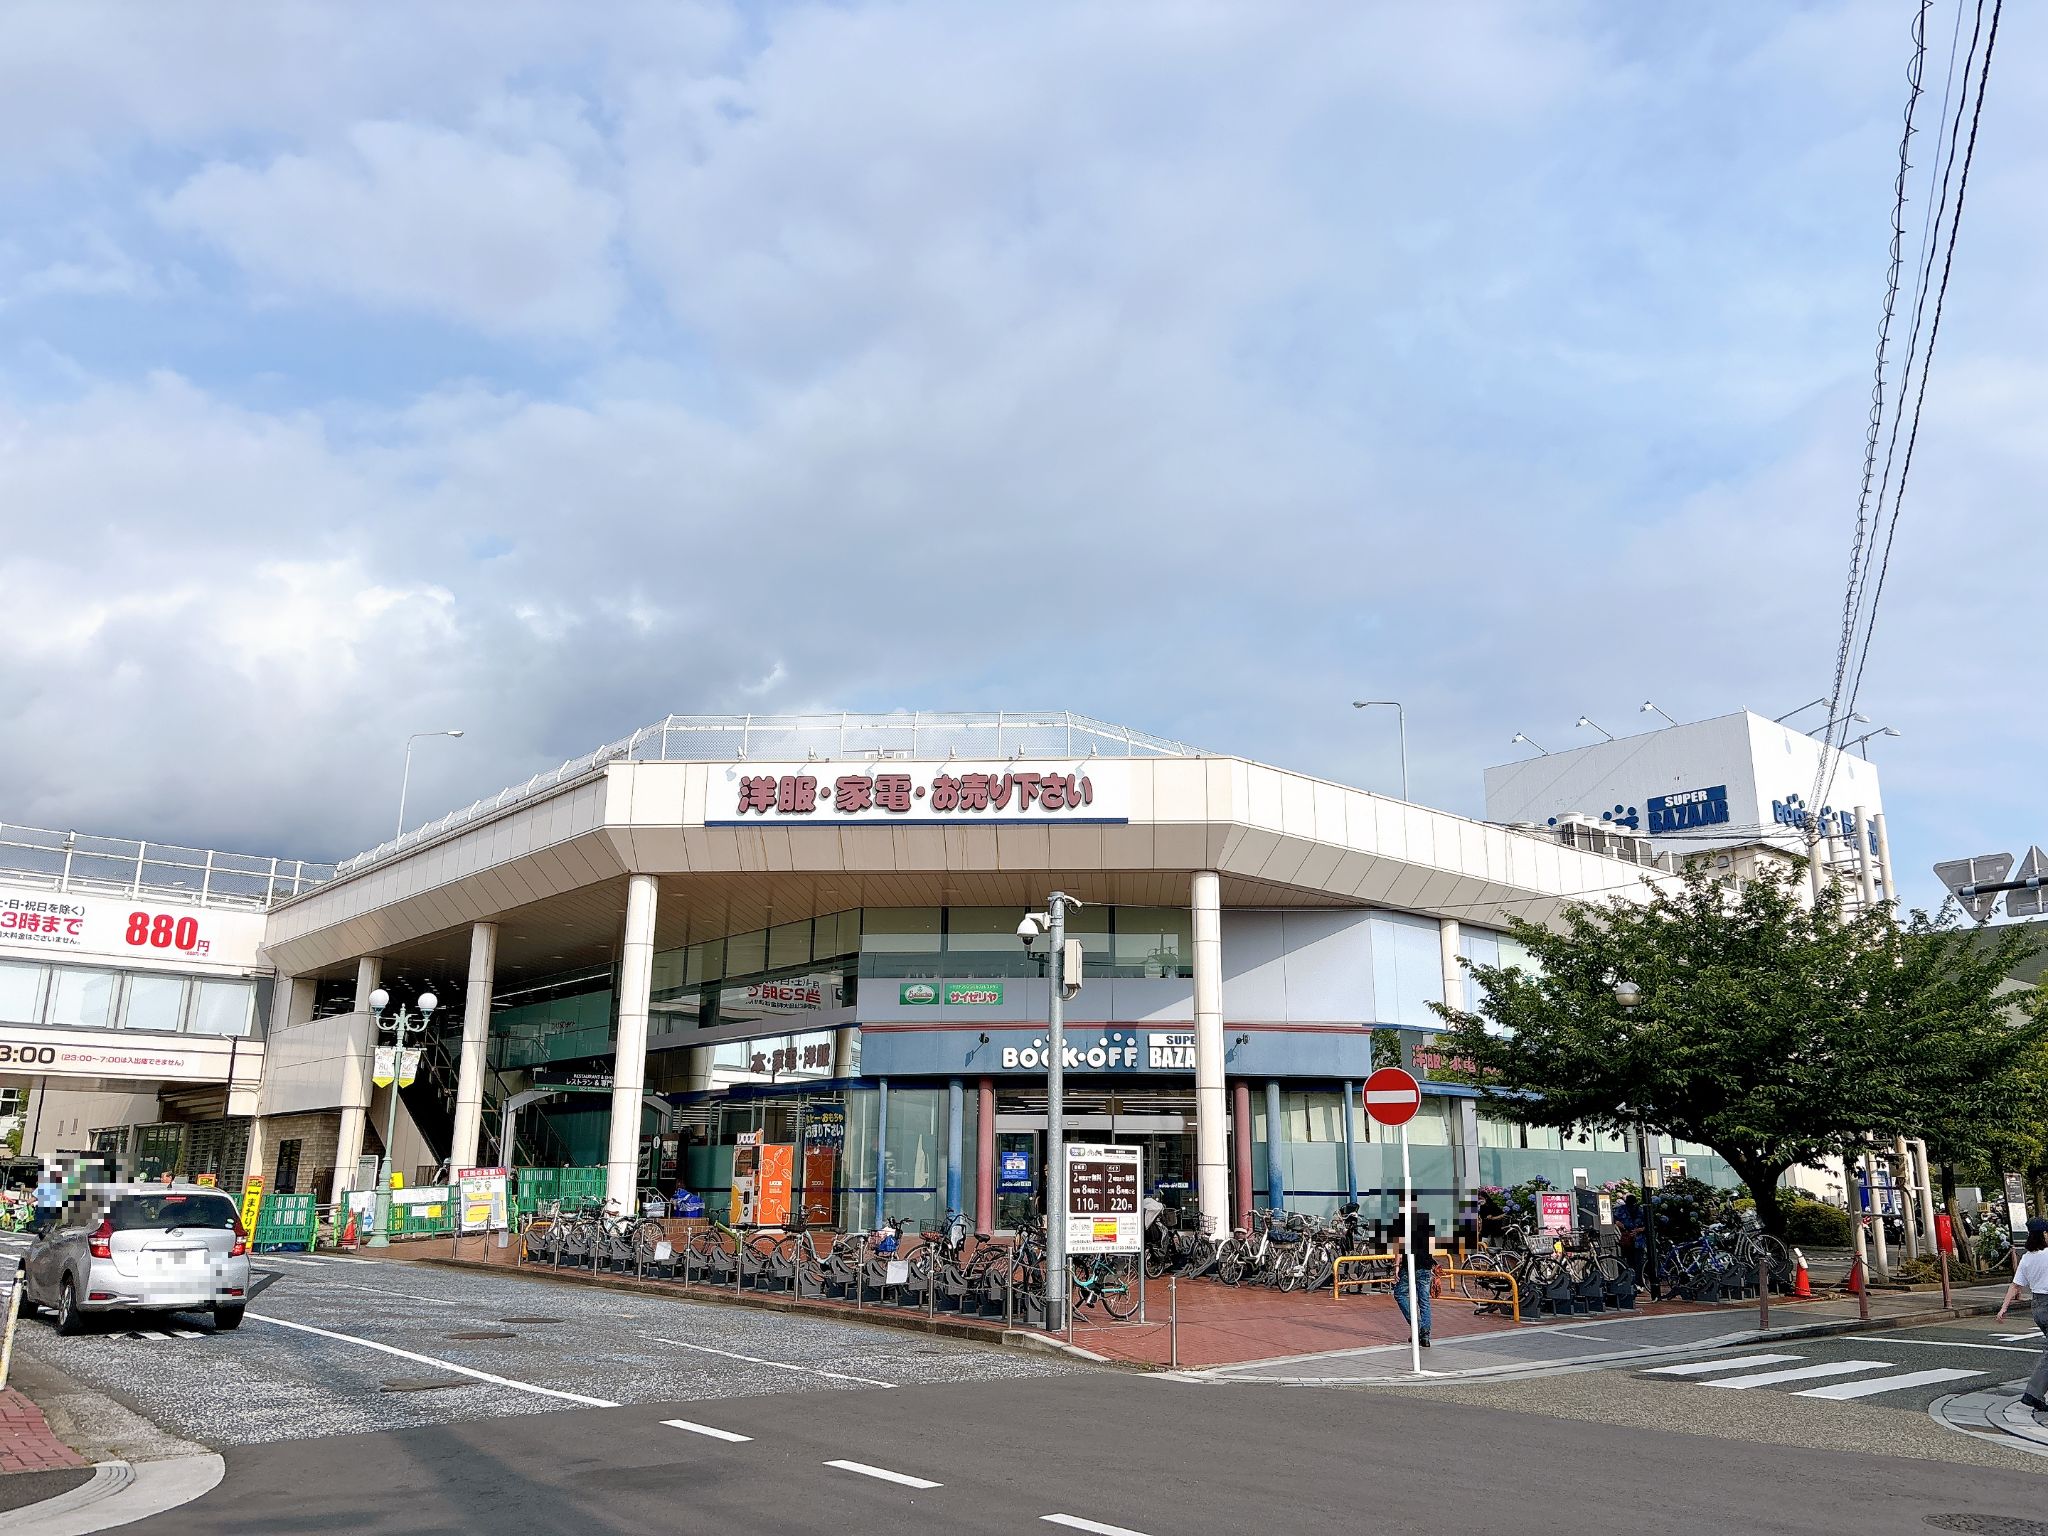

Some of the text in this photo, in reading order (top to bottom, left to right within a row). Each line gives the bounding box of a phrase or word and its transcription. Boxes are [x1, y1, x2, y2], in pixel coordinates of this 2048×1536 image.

[737, 774, 1093, 813] 洋服・家電・お売り下さい
[1665, 791, 1708, 808] SUPER
[1648, 800, 1730, 834] BAZAAR
[0, 911, 84, 935] 3時まで
[125, 911, 210, 953] 880円
[949, 991, 998, 1003] サイゼリヤ
[1166, 1035, 1195, 1045] SUPE
[750, 1042, 831, 1074] 本・家電・洋服
[1149, 1047, 1196, 1068] BAZA
[566, 1078, 593, 1086] レストラン
[601, 1079, 614, 1088] 専門
[1077, 1198, 1099, 1211] 110円
[1110, 1198, 1133, 1211] 220円
